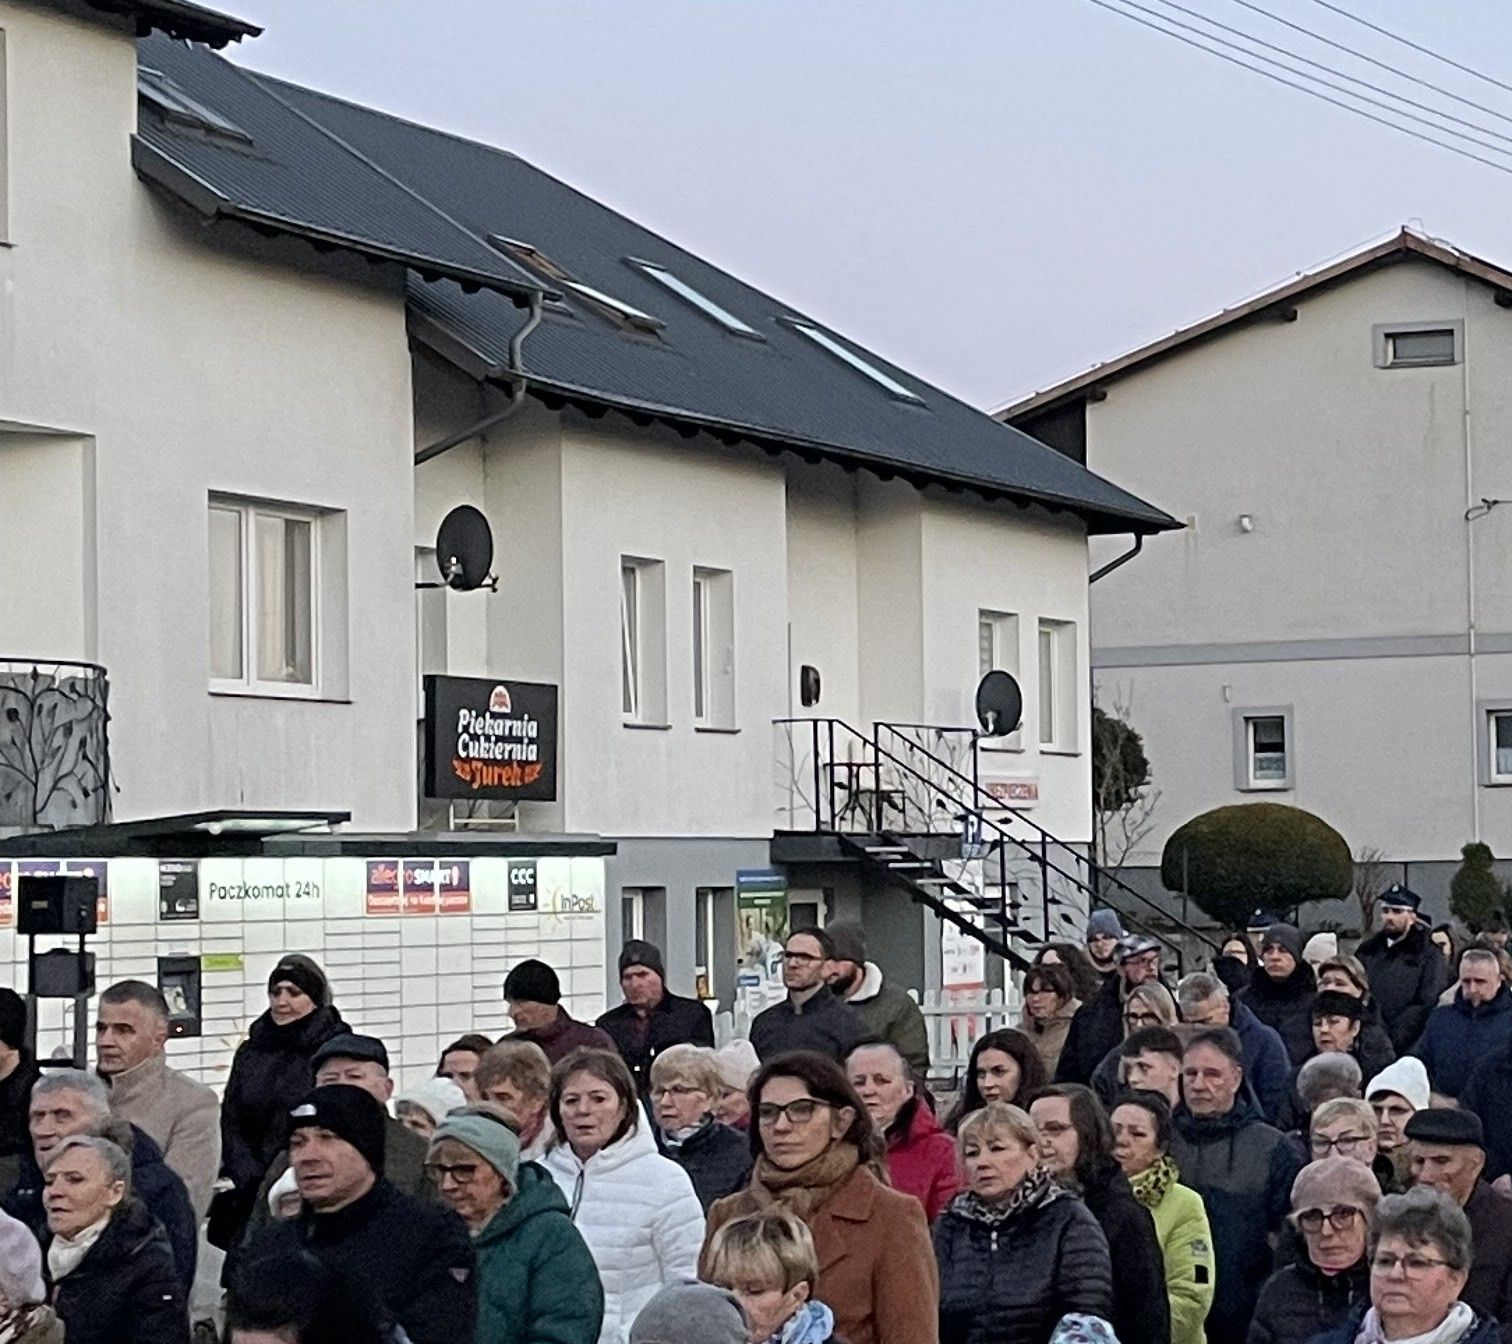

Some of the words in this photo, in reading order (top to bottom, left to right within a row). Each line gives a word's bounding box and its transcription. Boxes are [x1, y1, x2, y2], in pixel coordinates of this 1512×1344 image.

[457, 708, 538, 738] Piekarnia
[457, 732, 538, 761] Cukiernia
[510, 867, 535, 885] CCC
[209, 881, 290, 900] Paczkomat
[295, 880, 320, 899] 24h
